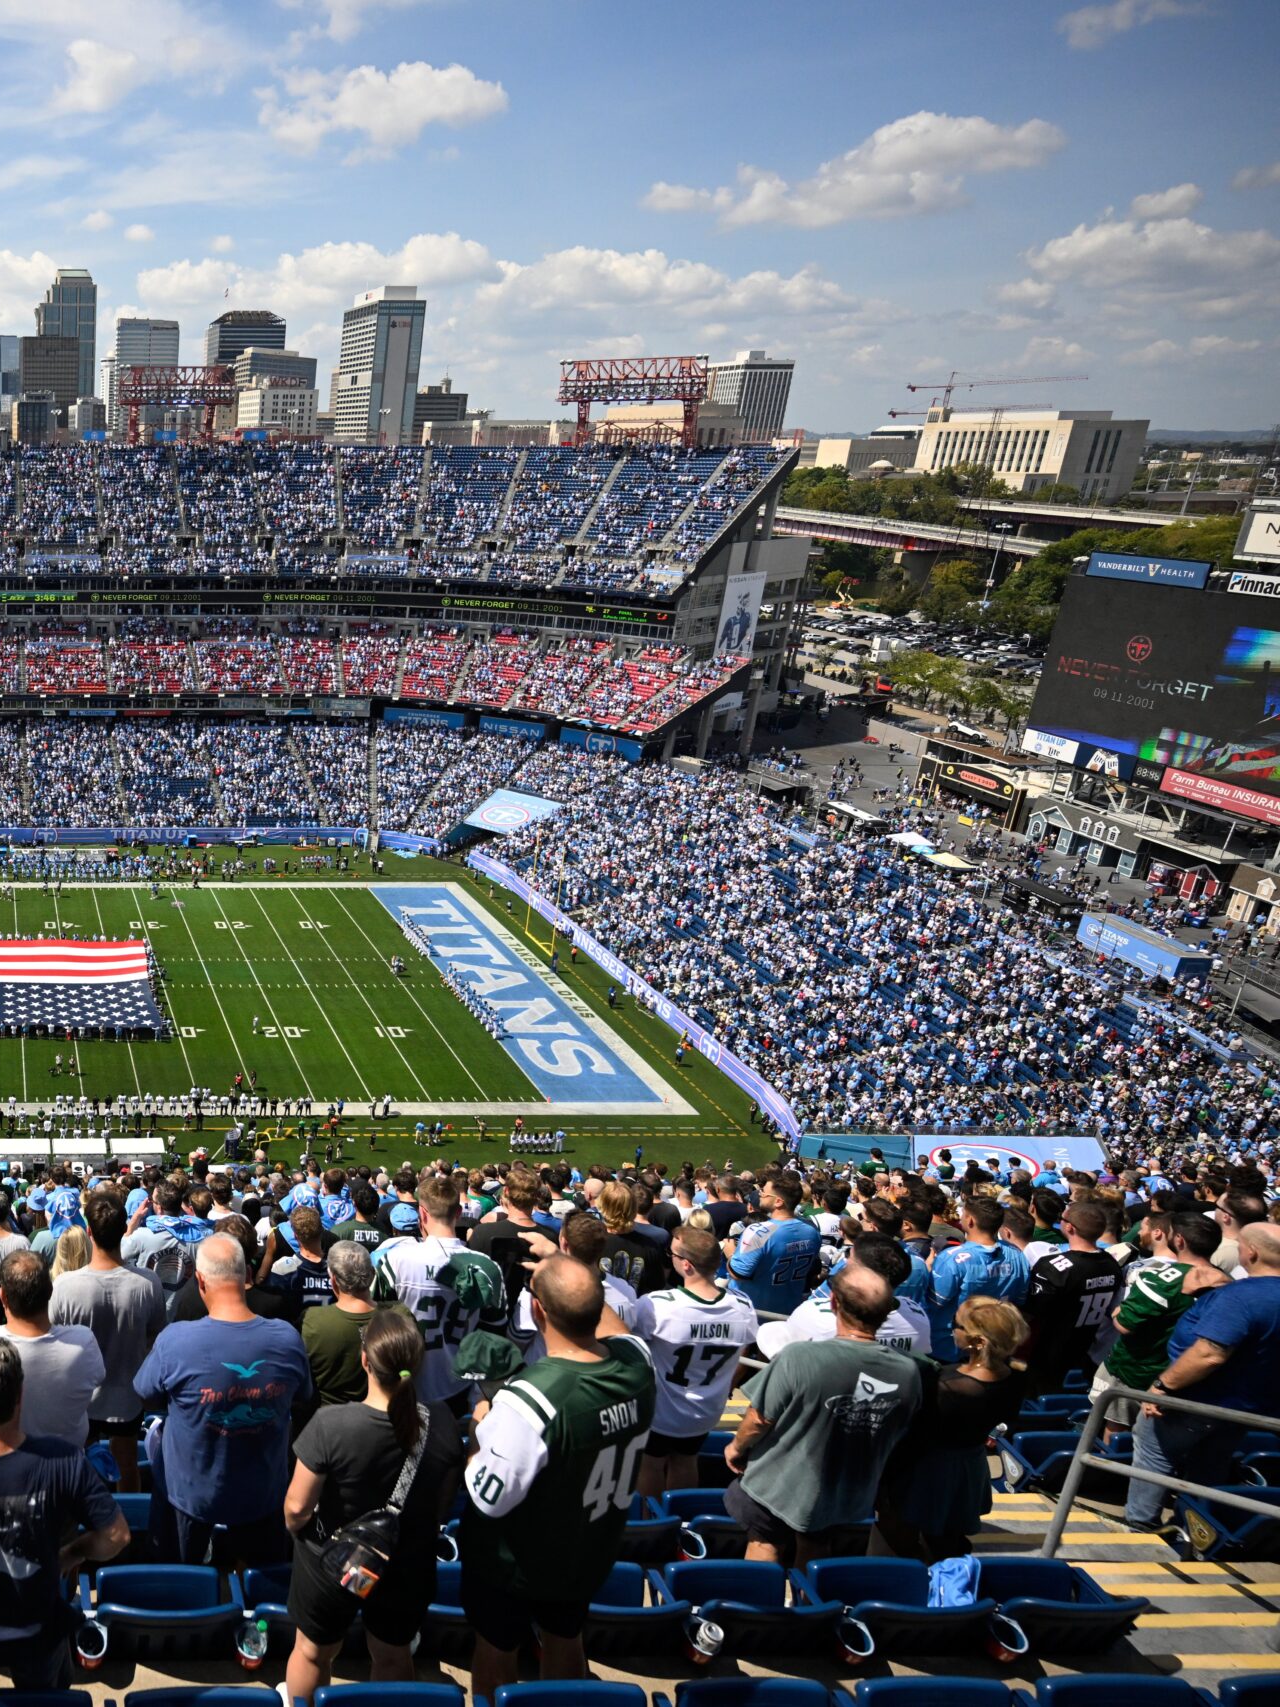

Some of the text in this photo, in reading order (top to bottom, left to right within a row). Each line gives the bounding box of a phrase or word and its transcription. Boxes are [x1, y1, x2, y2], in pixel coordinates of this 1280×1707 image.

[1098, 561, 1145, 573] VANDERBILT
[1160, 568, 1195, 578] HEALTH
[453, 598, 480, 607] NEVER
[482, 600, 515, 609] FORGET
[1093, 687, 1156, 710] 09.11.2001
[398, 715, 449, 727] TITANS
[483, 722, 540, 737] NISSAN
[1036, 732, 1067, 747] TITAN UP
[1171, 772, 1195, 786] Farm
[1196, 780, 1231, 797] Bureau
[110, 829, 188, 840] TITAN UP
[401, 899, 616, 1077] TITANS
[510, 941, 543, 969] TAKES
[537, 969, 560, 987] ALL
[558, 989, 575, 1004] OF
[574, 1004, 595, 1019] US
[261, 1027, 302, 1038] 20
[374, 1027, 406, 1038] 10
[353, 1229, 380, 1243] REVIS
[771, 1252, 815, 1286] 22
[1049, 1255, 1073, 1272] 18
[302, 1276, 332, 1289] JONES
[1085, 1275, 1116, 1290] COUSINS
[1075, 1291, 1114, 1328] 18
[416, 1295, 482, 1350] 28
[690, 1323, 730, 1339] WILSON
[665, 1344, 739, 1387] 17
[600, 1398, 638, 1436] SNOW
[582, 1428, 651, 1523] 40
[472, 1463, 505, 1506] 40
